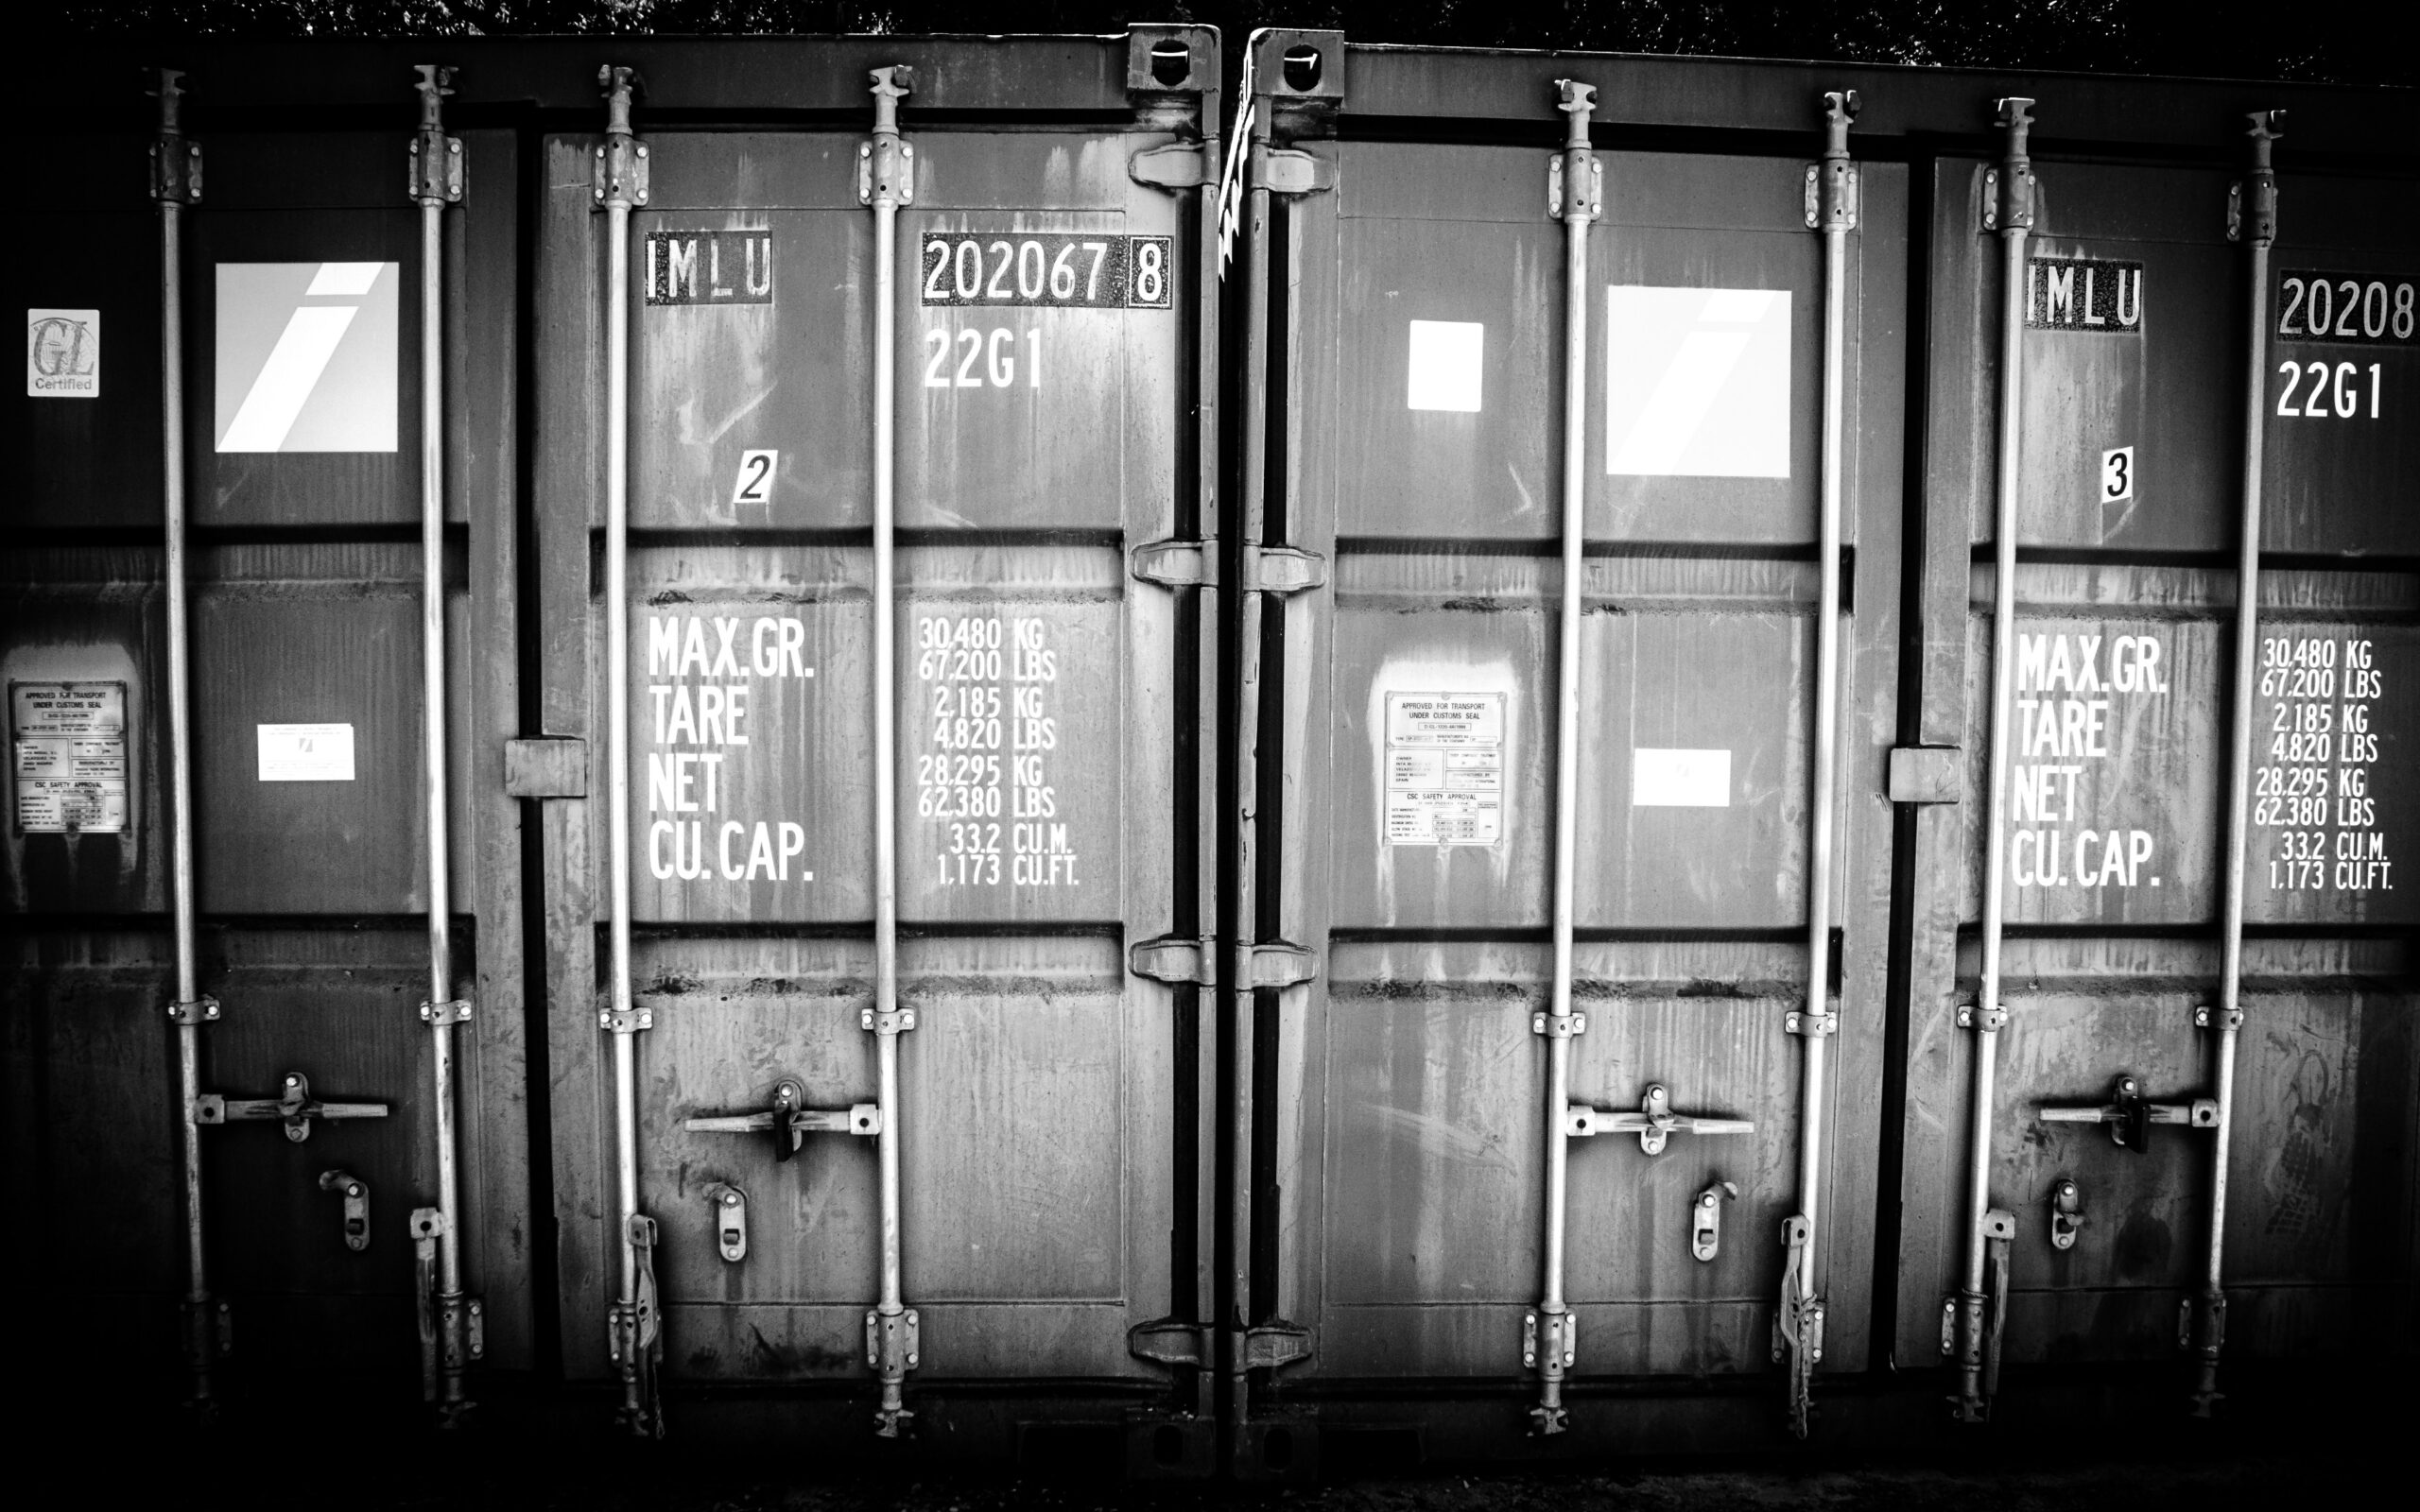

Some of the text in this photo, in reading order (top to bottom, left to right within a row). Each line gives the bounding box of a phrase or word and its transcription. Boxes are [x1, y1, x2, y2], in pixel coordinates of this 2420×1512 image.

[647, 238, 770, 298] IMLU
[924, 240, 1163, 302] 202067 8
[2027, 265, 2141, 326] IMLU
[2279, 278, 2414, 339] 20208
[924, 328, 1041, 388] 22G1
[35, 377, 92, 390] Certified
[2276, 360, 2381, 419] 22G1
[739, 455, 771, 500] 2
[2106, 452, 2128, 497] 3
[919, 617, 1044, 649] 30,480 KG
[918, 649, 1057, 681] 67,200 LBS
[2263, 638, 2372, 670] 30,480 KG
[2260, 668, 2381, 699] 67,200 LBS
[648, 685, 749, 745] TARE
[934, 685, 1043, 718] 2,185 KG
[2273, 702, 2369, 733] 2,185 KG
[933, 717, 1056, 750] 4,820 LBS
[2017, 699, 2109, 757] TARE
[2272, 732, 2378, 763] 4,820 LBS
[648, 752, 723, 812] NET
[918, 754, 1043, 787] 28,295 KG
[2256, 766, 2365, 798] 28,295 KG
[918, 786, 1056, 818] 62,380 LBS
[2012, 765, 2083, 822] NET
[2255, 797, 2376, 827] 62,380 LBS
[949, 822, 1001, 854] 33.2
[2281, 831, 2325, 861] 33.2
[937, 854, 1000, 885] 1,173
[2270, 860, 2325, 889] 1,173
